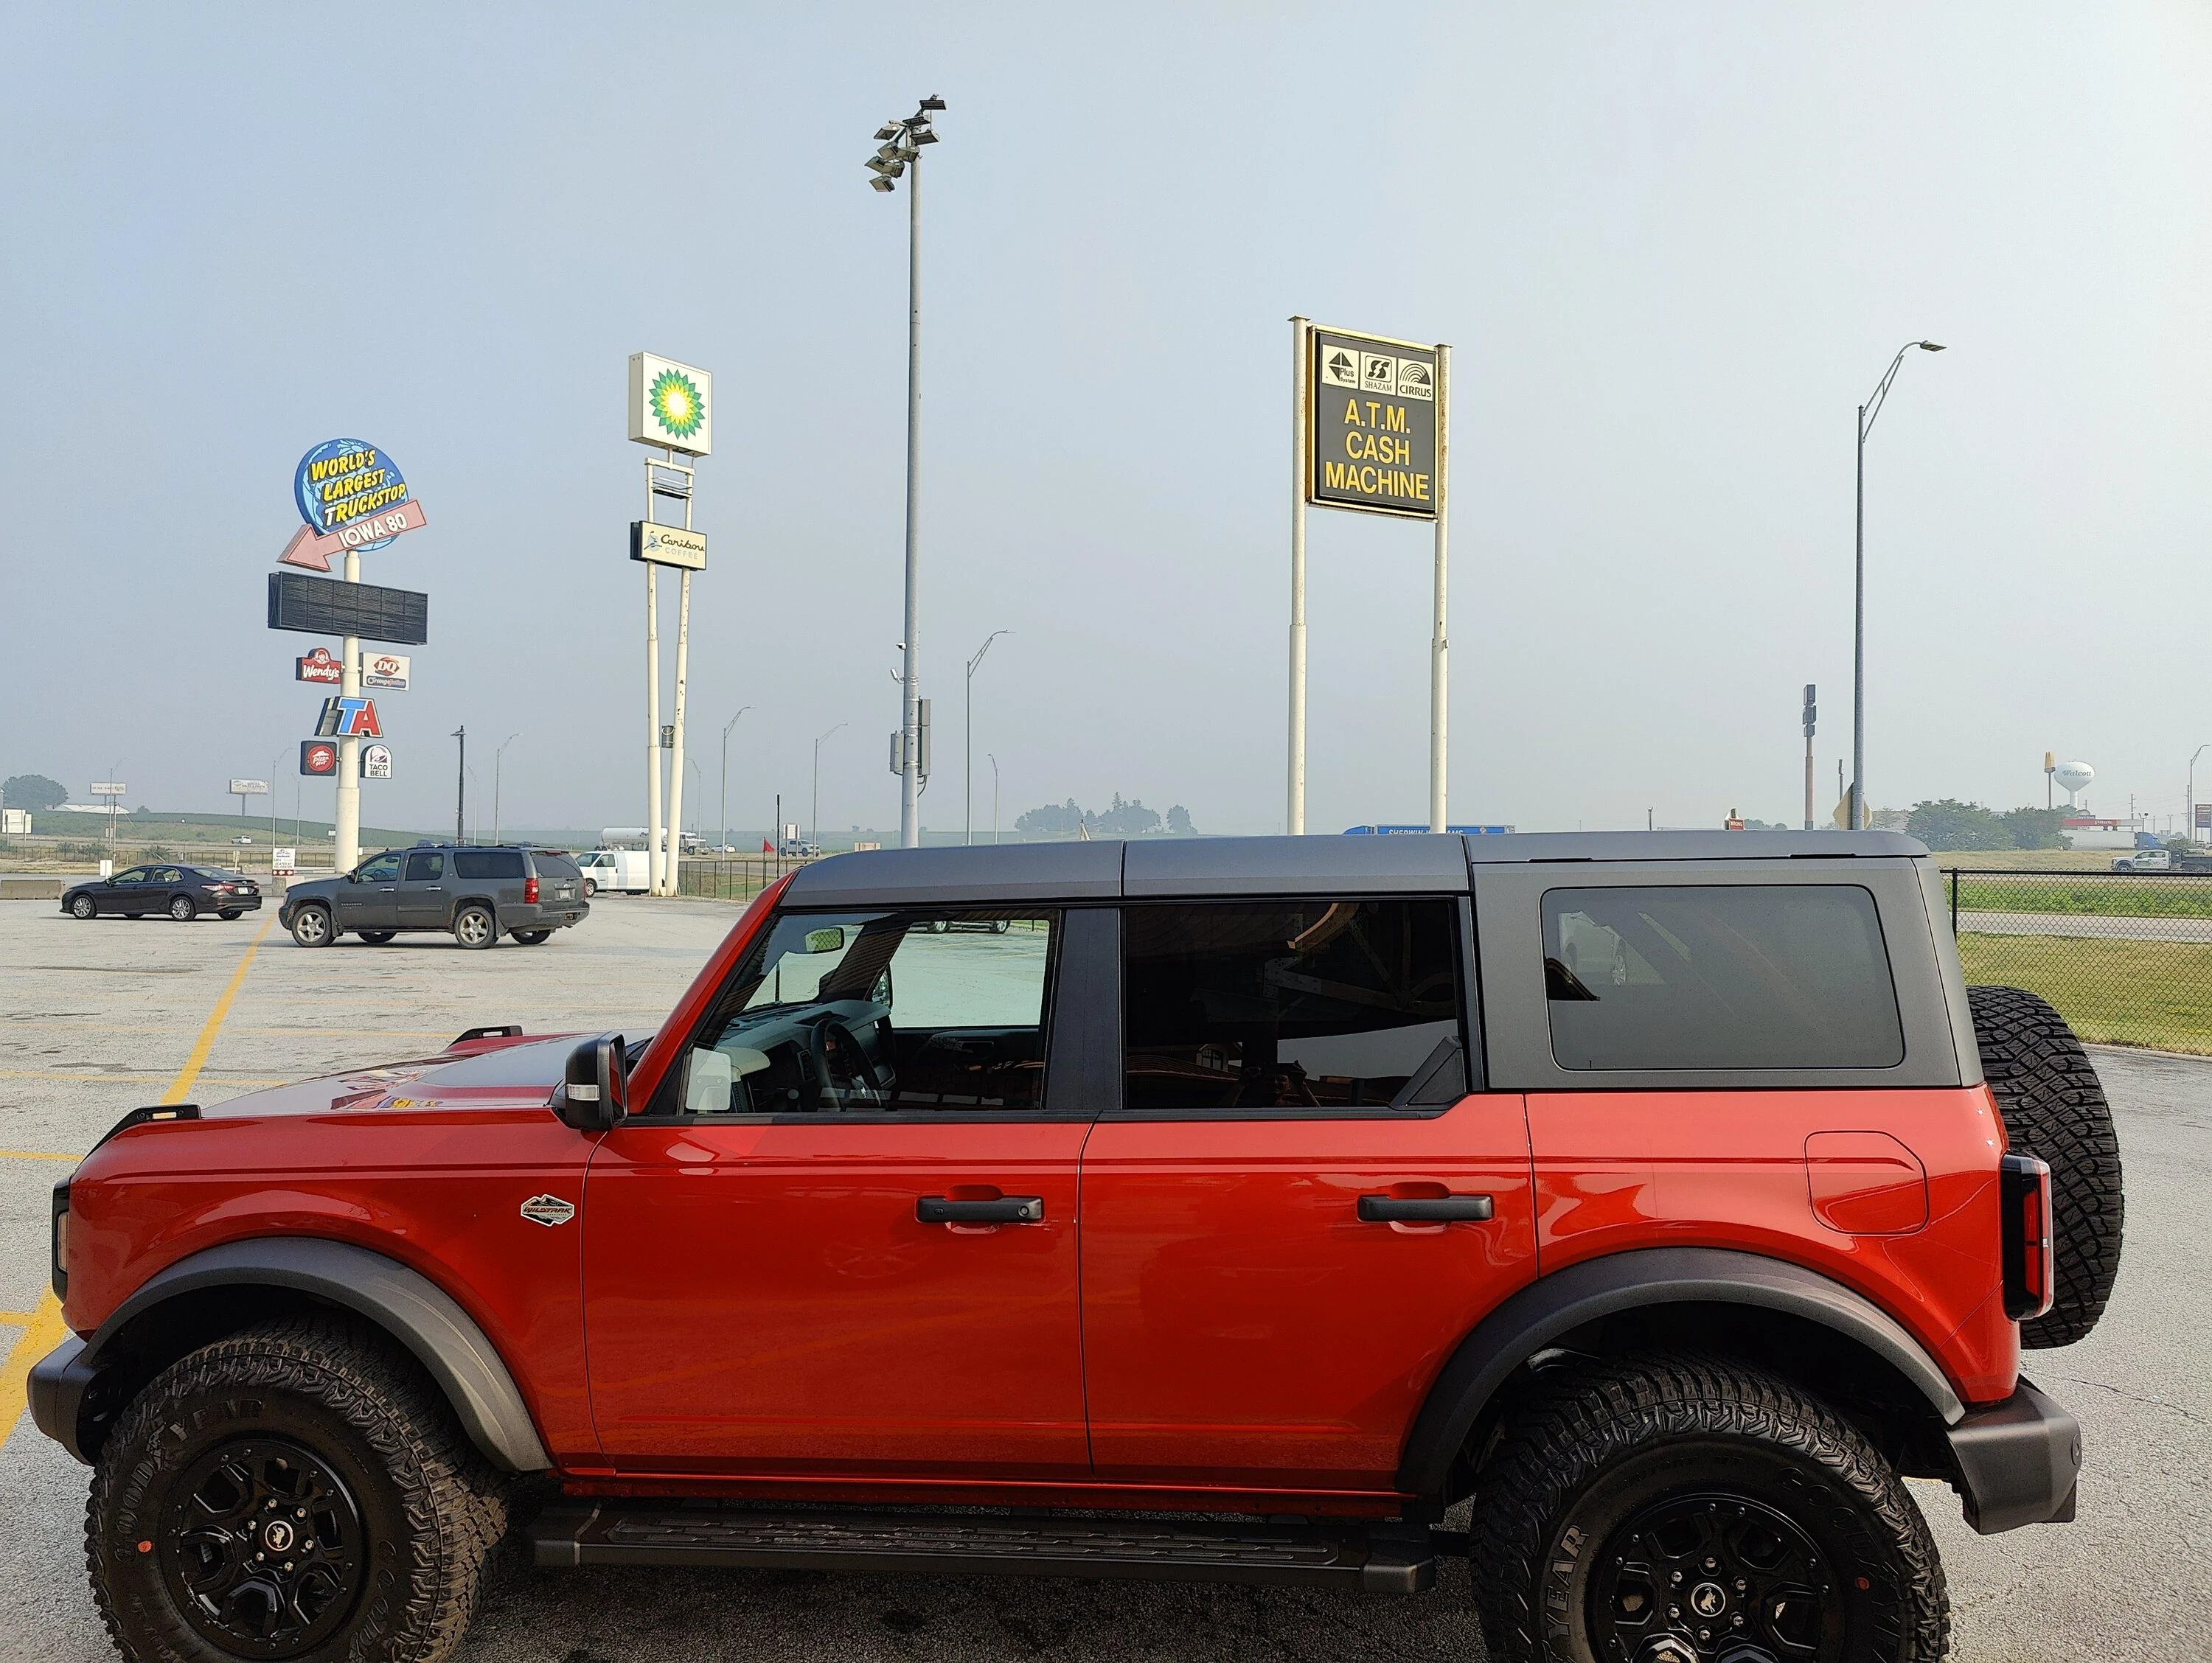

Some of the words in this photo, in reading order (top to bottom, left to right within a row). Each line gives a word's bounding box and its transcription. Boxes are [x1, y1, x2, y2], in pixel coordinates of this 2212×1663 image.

[1340, 368, 1354, 377] Plus
[1364, 380, 1392, 392] SHAZAM
[1399, 385, 1432, 398] CIRRUS
[1343, 398, 1411, 434] A.T.M.
[310, 448, 376, 481] WORLD'S
[1346, 430, 1411, 467] CASH
[322, 468, 386, 502] LARGEST
[1325, 461, 1430, 501] MACHINE
[324, 482, 406, 527] TRUCKSTOP
[338, 523, 386, 548] IOWA
[386, 512, 407, 532] 80
[661, 534, 705, 551] Caribou
[665, 547, 698, 559] COFFEE
[303, 664, 340, 681] Wendy's
[377, 660, 397, 674] DQ
[337, 697, 383, 738] TA
